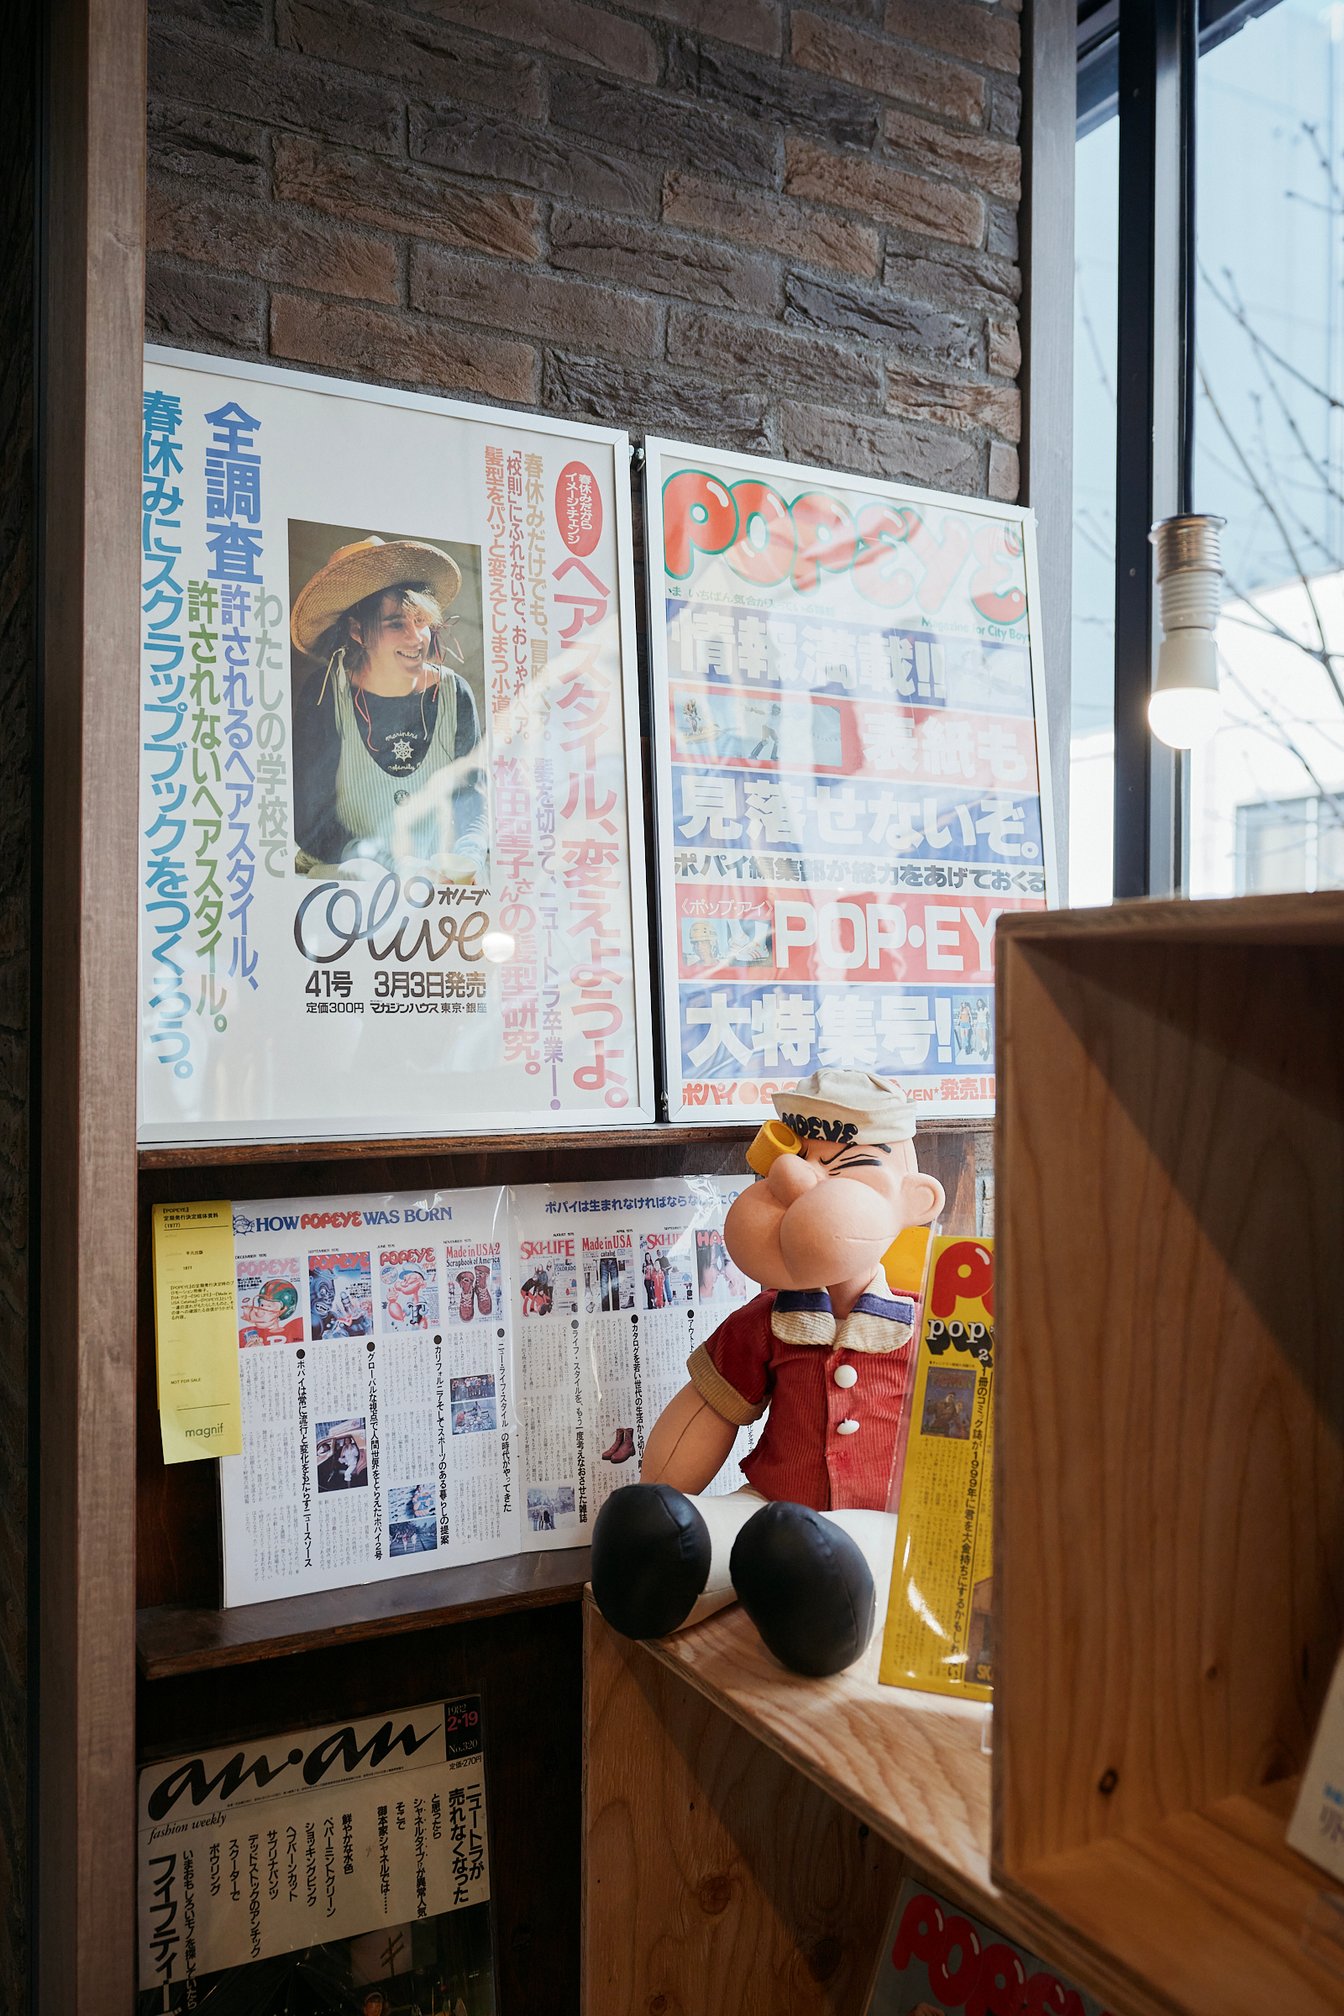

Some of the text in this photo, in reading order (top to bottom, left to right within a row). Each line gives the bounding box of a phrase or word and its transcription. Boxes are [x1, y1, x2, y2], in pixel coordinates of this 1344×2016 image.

[204, 401, 263, 585] 全調査
[973, 625, 986, 635] or
[988, 625, 1007, 640] City
[1010, 629, 1029, 643] Boy
[254, 587, 290, 878] わたしの学校で
[864, 713, 1027, 783] 表紙も
[187, 580, 229, 1032] 許されないヘアスタイル。
[221, 583, 258, 990] 許されるヘアスタイル、
[678, 775, 1040, 860] 見落せないぞ。
[552, 557, 630, 1108] ヘアスタイル、変えようよ。
[294, 872, 491, 964] Olive
[305, 970, 487, 999] 41号 3月3日発売
[306, 1002, 365, 1014] 定価300円
[370, 1000, 440, 1014] マガジンハウス
[685, 991, 953, 1068] 大特集号!
[256, 1206, 452, 1234] HOW POPEYE WAS BORN
[446, 1245, 467, 1259] Made
[468, 1244, 475, 1257] in
[582, 1234, 633, 1252] Made in USA
[237, 1257, 299, 1277] POPEYE
[379, 1247, 436, 1266] POPEYE
[185, 1422, 224, 1438] magnif
[447, 1703, 468, 1716] 1982
[449, 1738, 478, 1755] No.320
[148, 1812, 227, 1845] fashion weekly
[341, 1813, 354, 1875] 鮮やかな水色
[395, 1801, 406, 1831] そこで
[431, 1794, 443, 1841] と思ったら
[448, 1787, 469, 1905] 売れなくなった
[465, 1783, 485, 1881] ニュートラが
[209, 1843, 221, 1897] ボウリング
[228, 1839, 241, 1902] スクーターで
[248, 1833, 261, 1959] デッドストックのアンチック
[266, 1829, 279, 1901] サブリナパンツ
[304, 1822, 317, 1908] ショッキングピンク
[323, 1817, 336, 1918] ペパーミントグリーン
[148, 1853, 182, 2016] フィフティー
[182, 1850, 197, 2010] いまおもしろいモノを探していたら
